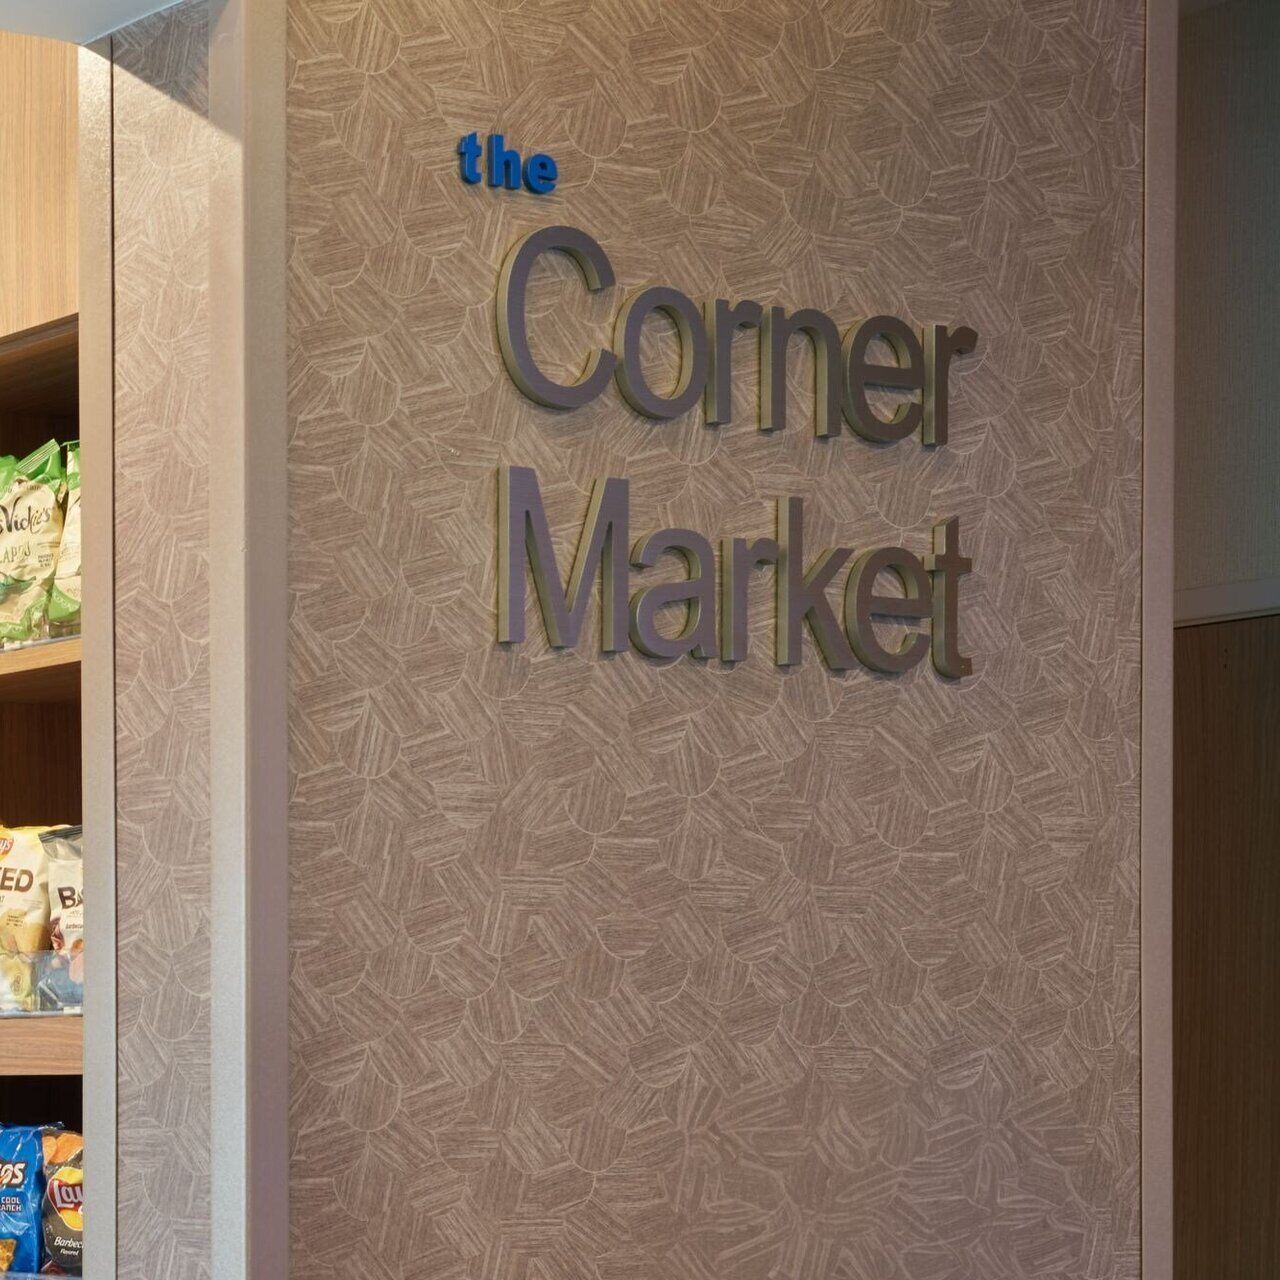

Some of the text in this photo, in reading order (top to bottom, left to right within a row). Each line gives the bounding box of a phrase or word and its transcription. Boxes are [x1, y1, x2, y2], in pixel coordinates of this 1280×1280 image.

[458, 131, 558, 194] the
[496, 225, 978, 447] Corner
[497, 465, 973, 679] Market
